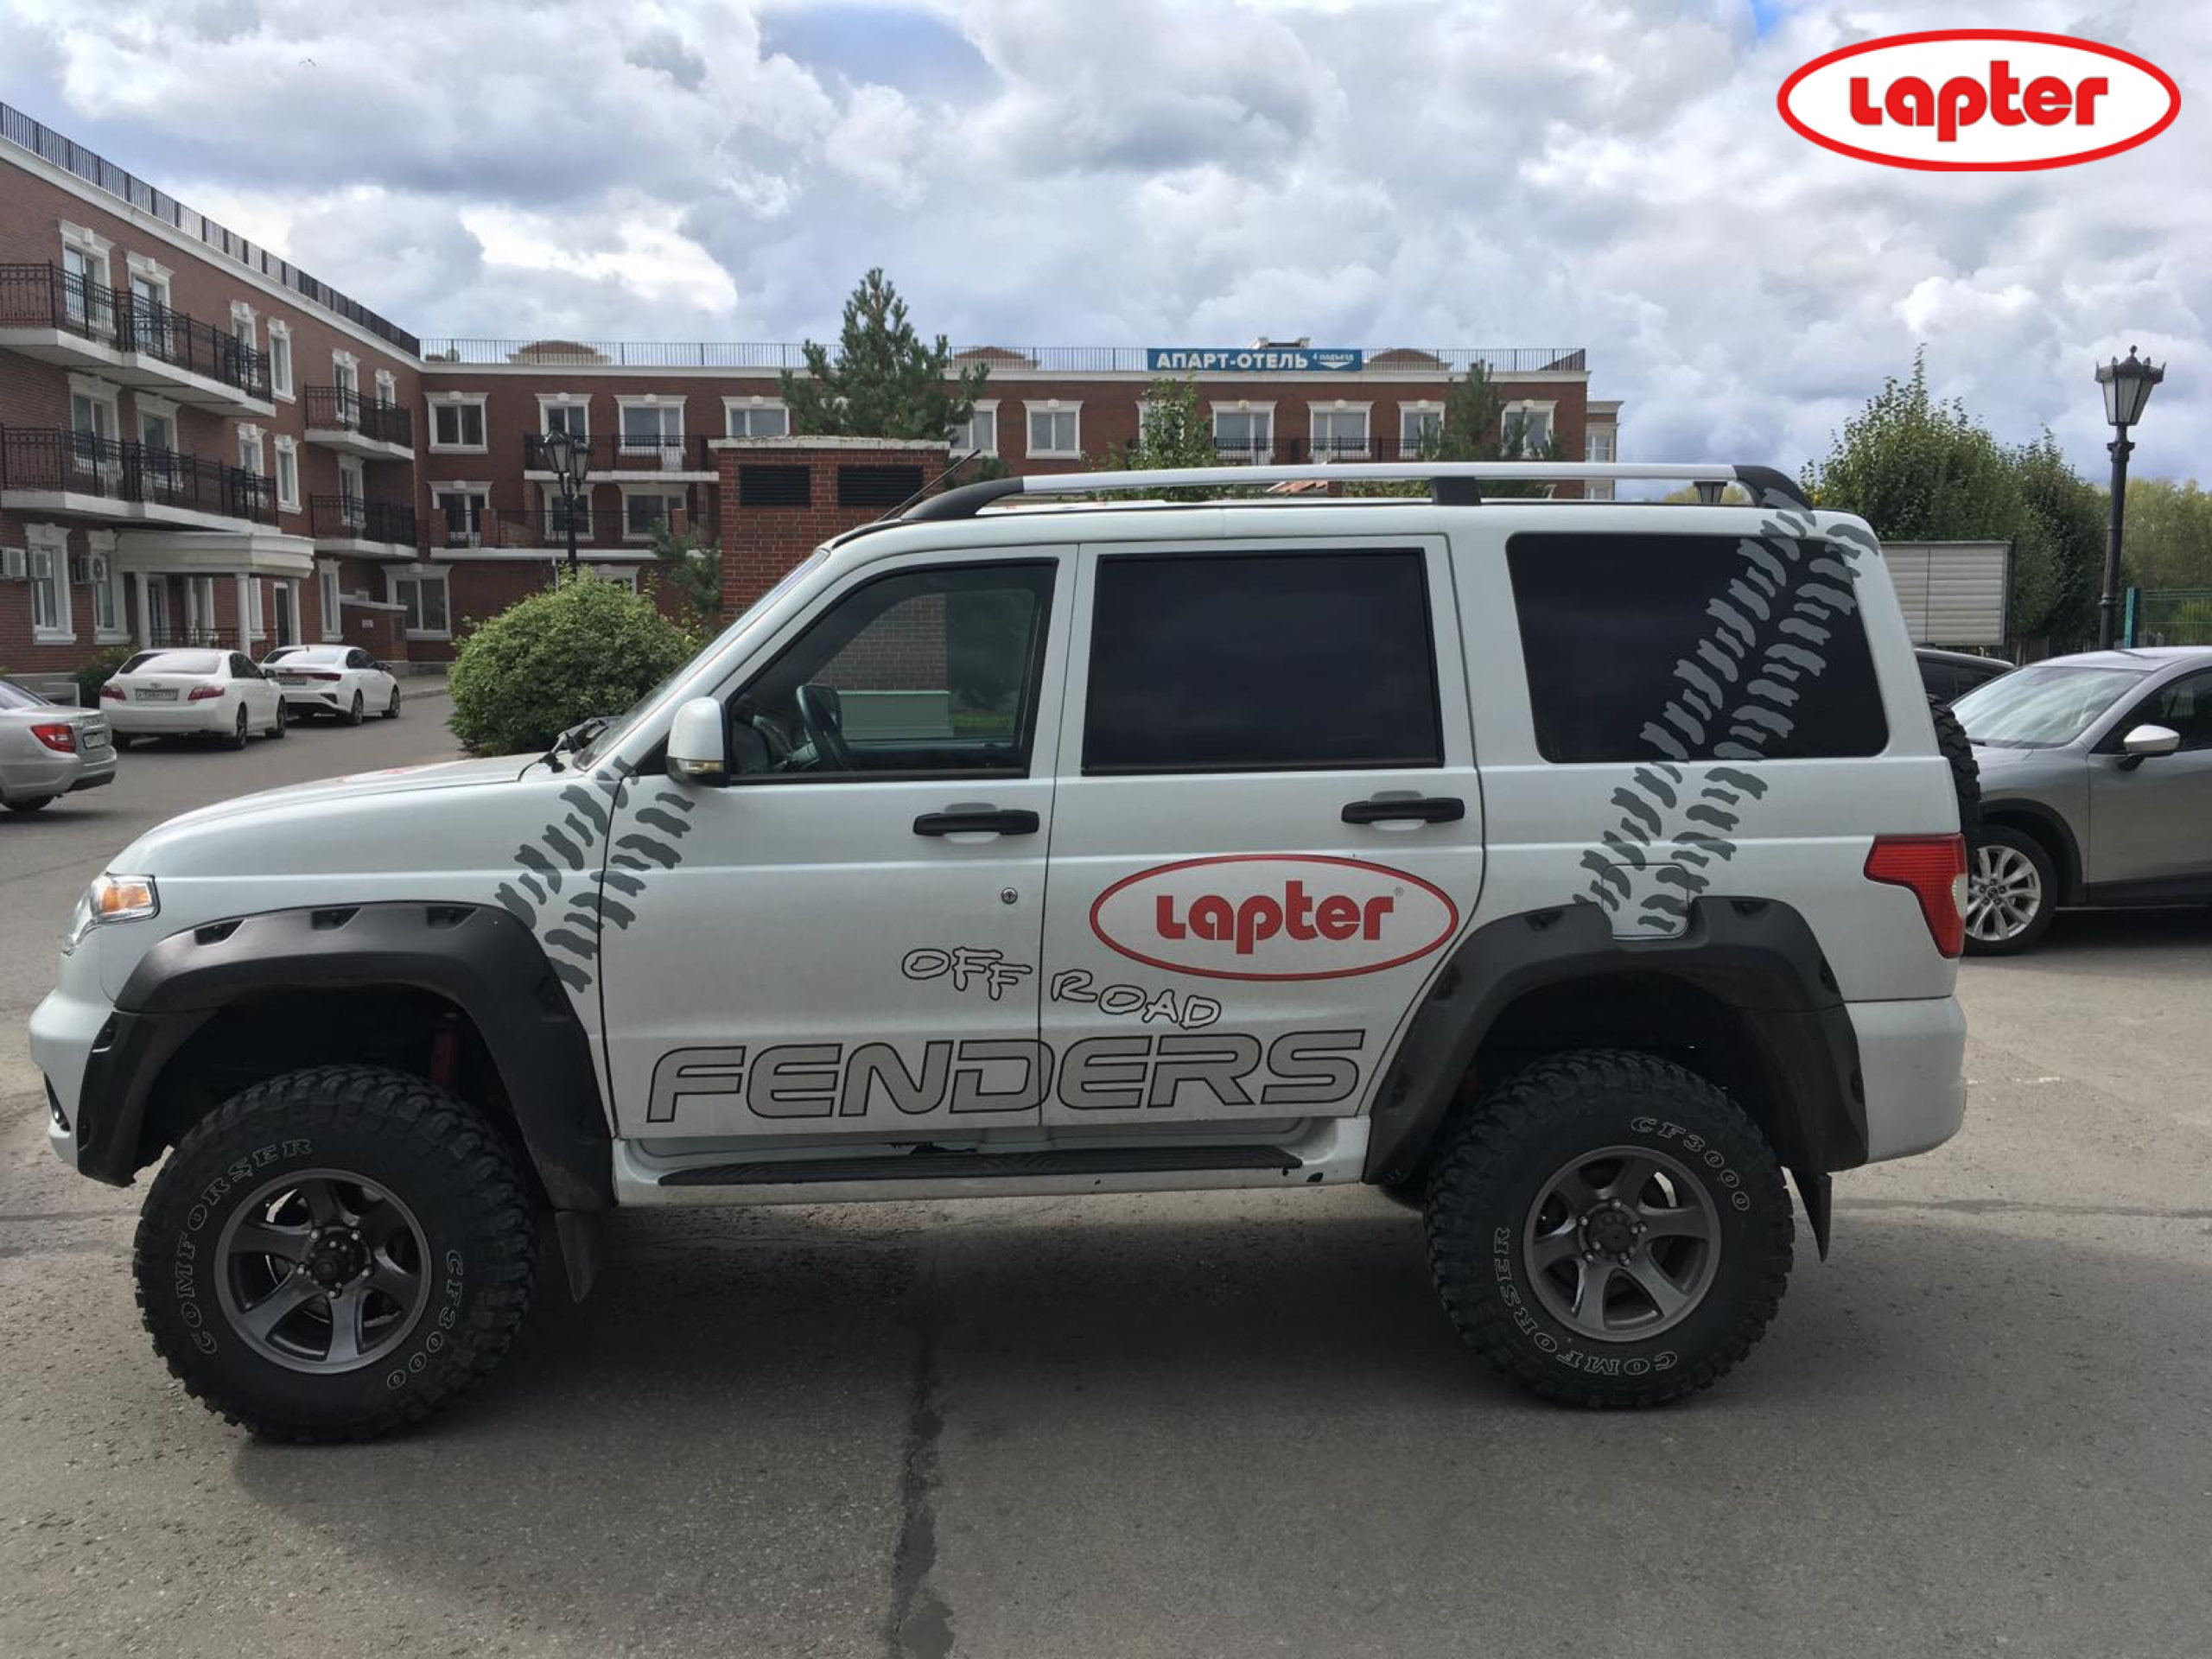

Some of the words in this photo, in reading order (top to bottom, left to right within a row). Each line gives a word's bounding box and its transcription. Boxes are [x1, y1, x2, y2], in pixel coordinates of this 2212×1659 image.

[1156, 353, 1309, 369] АПАРТ-ОТЕЛЬ
[1156, 880, 1395, 955] Lapter
[901, 948, 1033, 1001] OFF
[1050, 969, 1223, 1030] ROAD
[646, 1029, 1366, 1123] FENDERS
[1630, 1116, 1751, 1212] CF3000
[174, 1137, 315, 1356] COMFORSER
[386, 1249, 466, 1391] CF3000
[1493, 1226, 1679, 1376] COMFORSER
